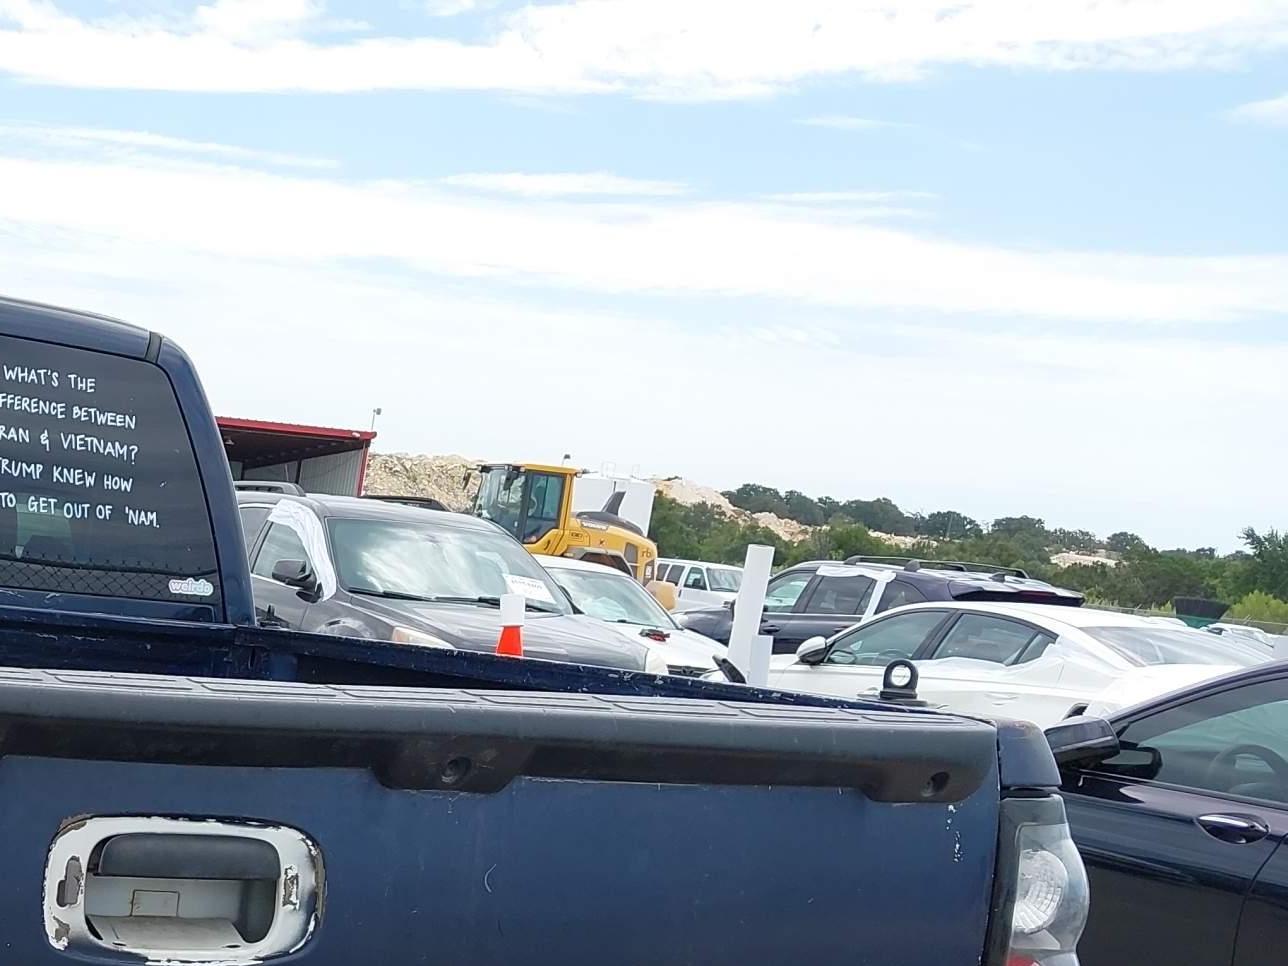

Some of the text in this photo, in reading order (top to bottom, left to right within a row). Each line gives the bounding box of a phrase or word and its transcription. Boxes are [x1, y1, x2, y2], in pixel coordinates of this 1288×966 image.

[3, 365, 96, 393] WHAT'S THE
[72, 406, 136, 429] BETWEEN
[40, 429, 50, 451] &
[60, 432, 138, 465] VIETNAM?
[53, 465, 96, 488] KNEW
[103, 474, 133, 493] HOW
[28, 496, 58, 515] GET
[63, 503, 90, 519] OUT
[96, 504, 112, 520] OF
[125, 506, 160, 528] 'NAM.
[170, 579, 212, 595] weirdo
